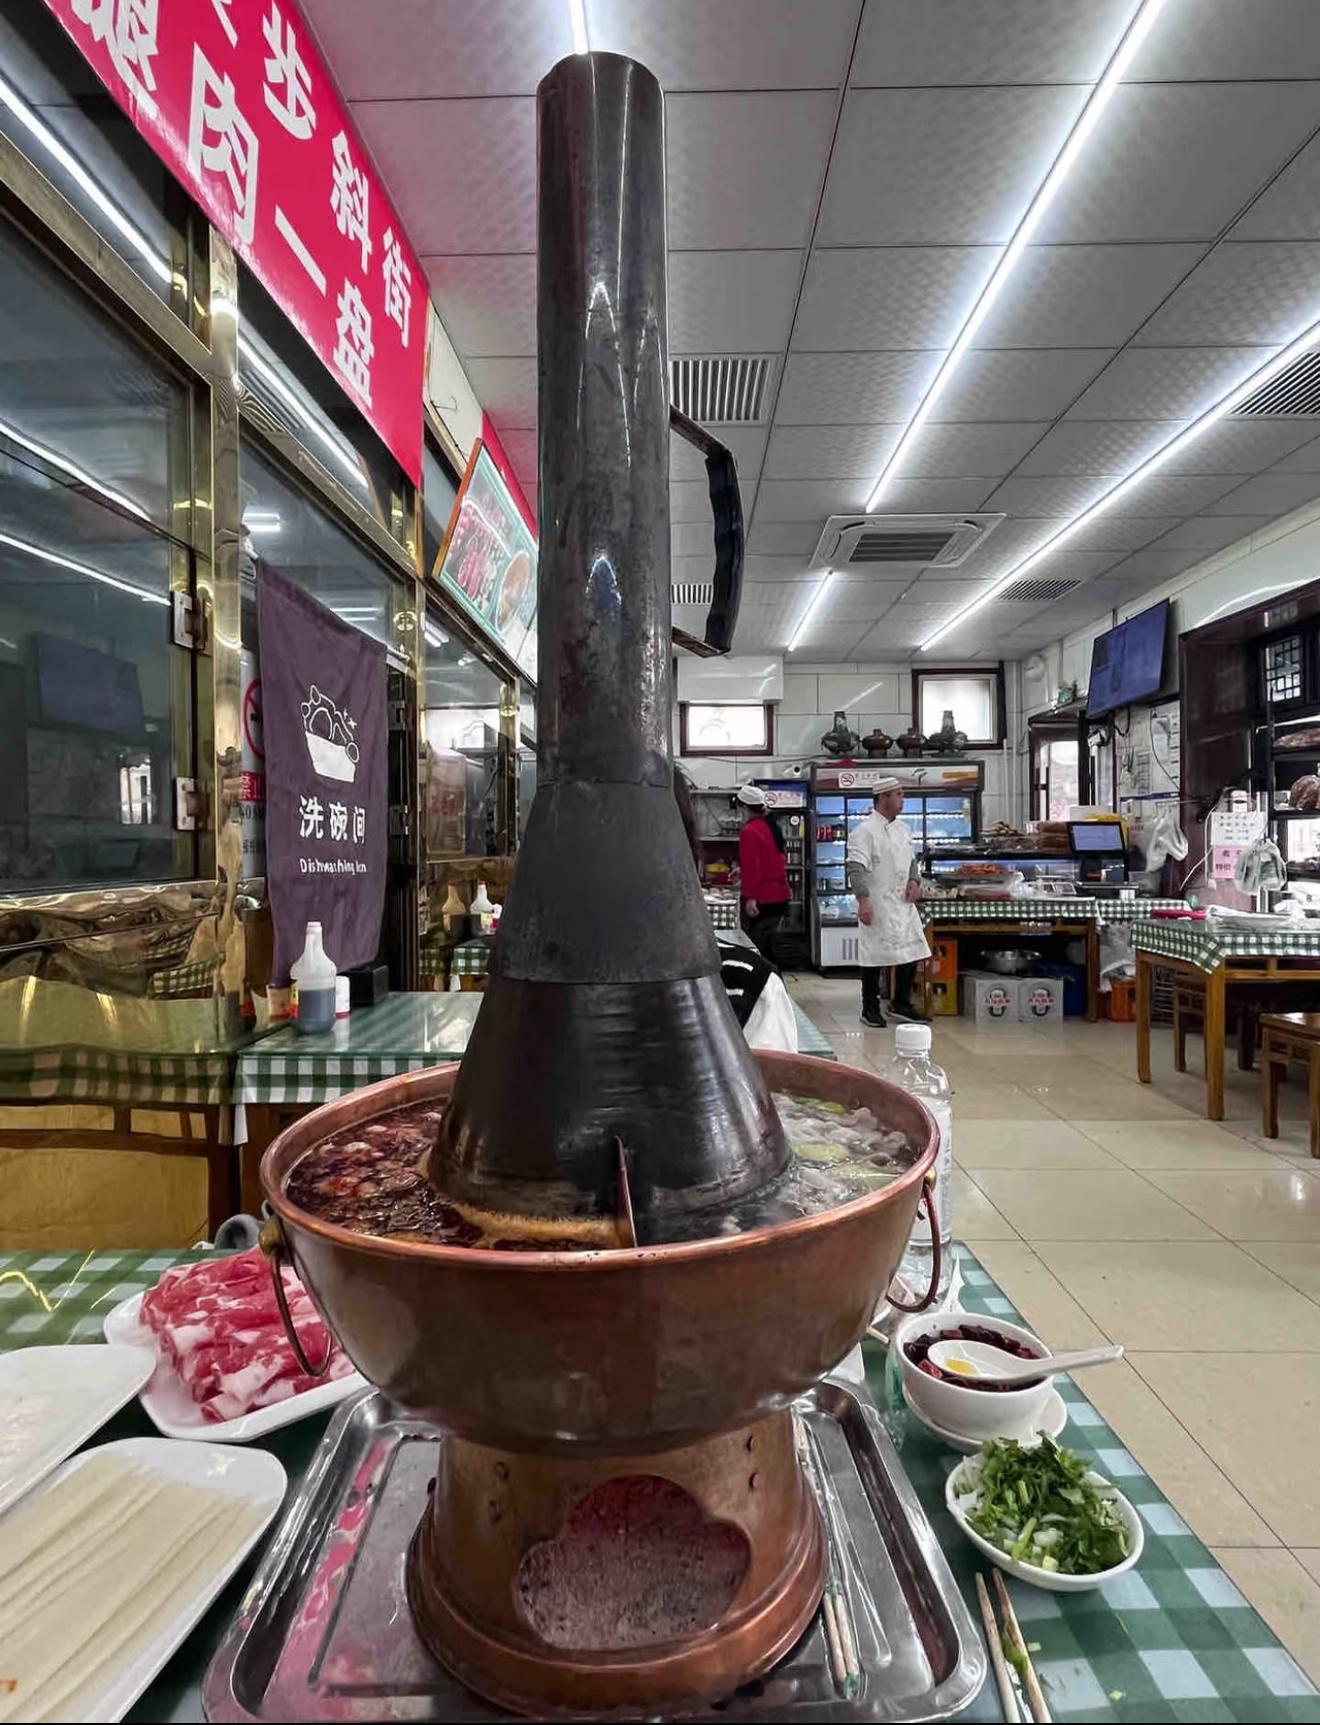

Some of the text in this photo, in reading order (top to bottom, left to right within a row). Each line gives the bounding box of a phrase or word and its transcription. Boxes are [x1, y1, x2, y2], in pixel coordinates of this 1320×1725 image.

[210, 0, 412, 348] 步斜街
[299, 795, 366, 844] 洗碗间
